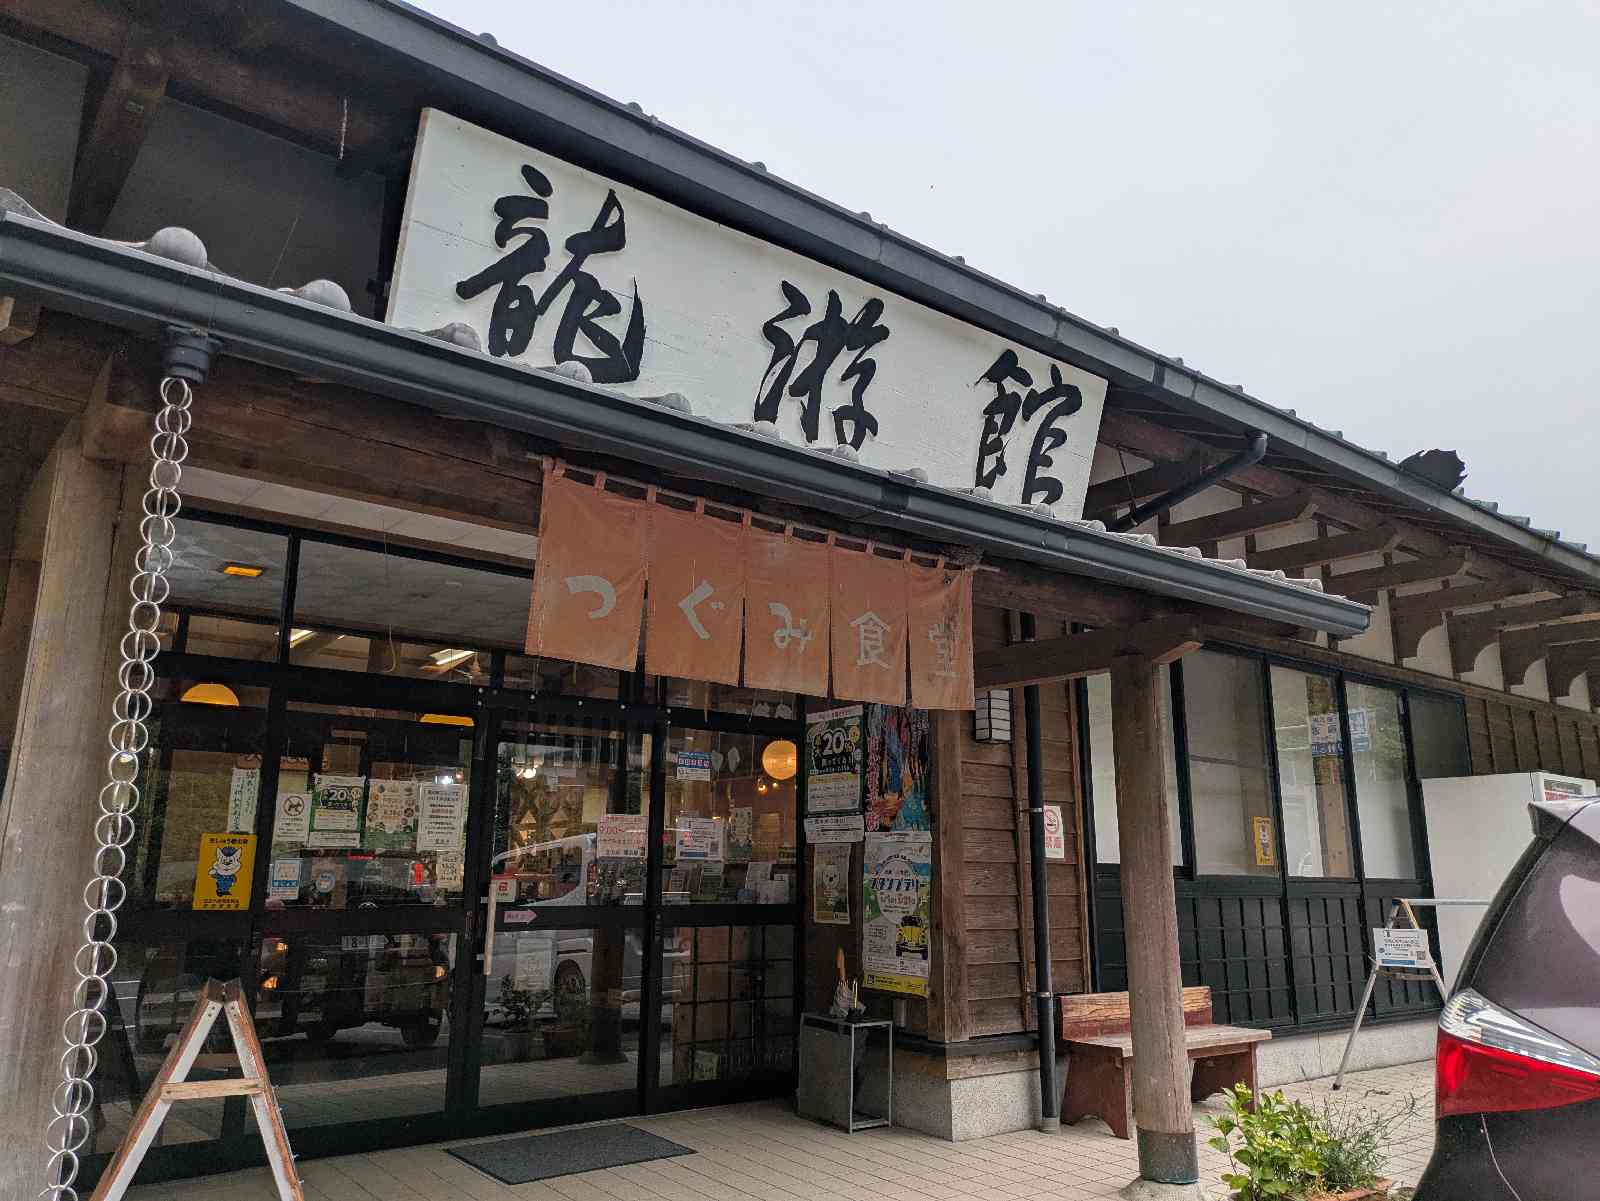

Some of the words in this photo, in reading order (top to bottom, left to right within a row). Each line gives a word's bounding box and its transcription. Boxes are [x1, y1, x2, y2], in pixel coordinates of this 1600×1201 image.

[565, 574, 961, 682] つぐみ食堂
